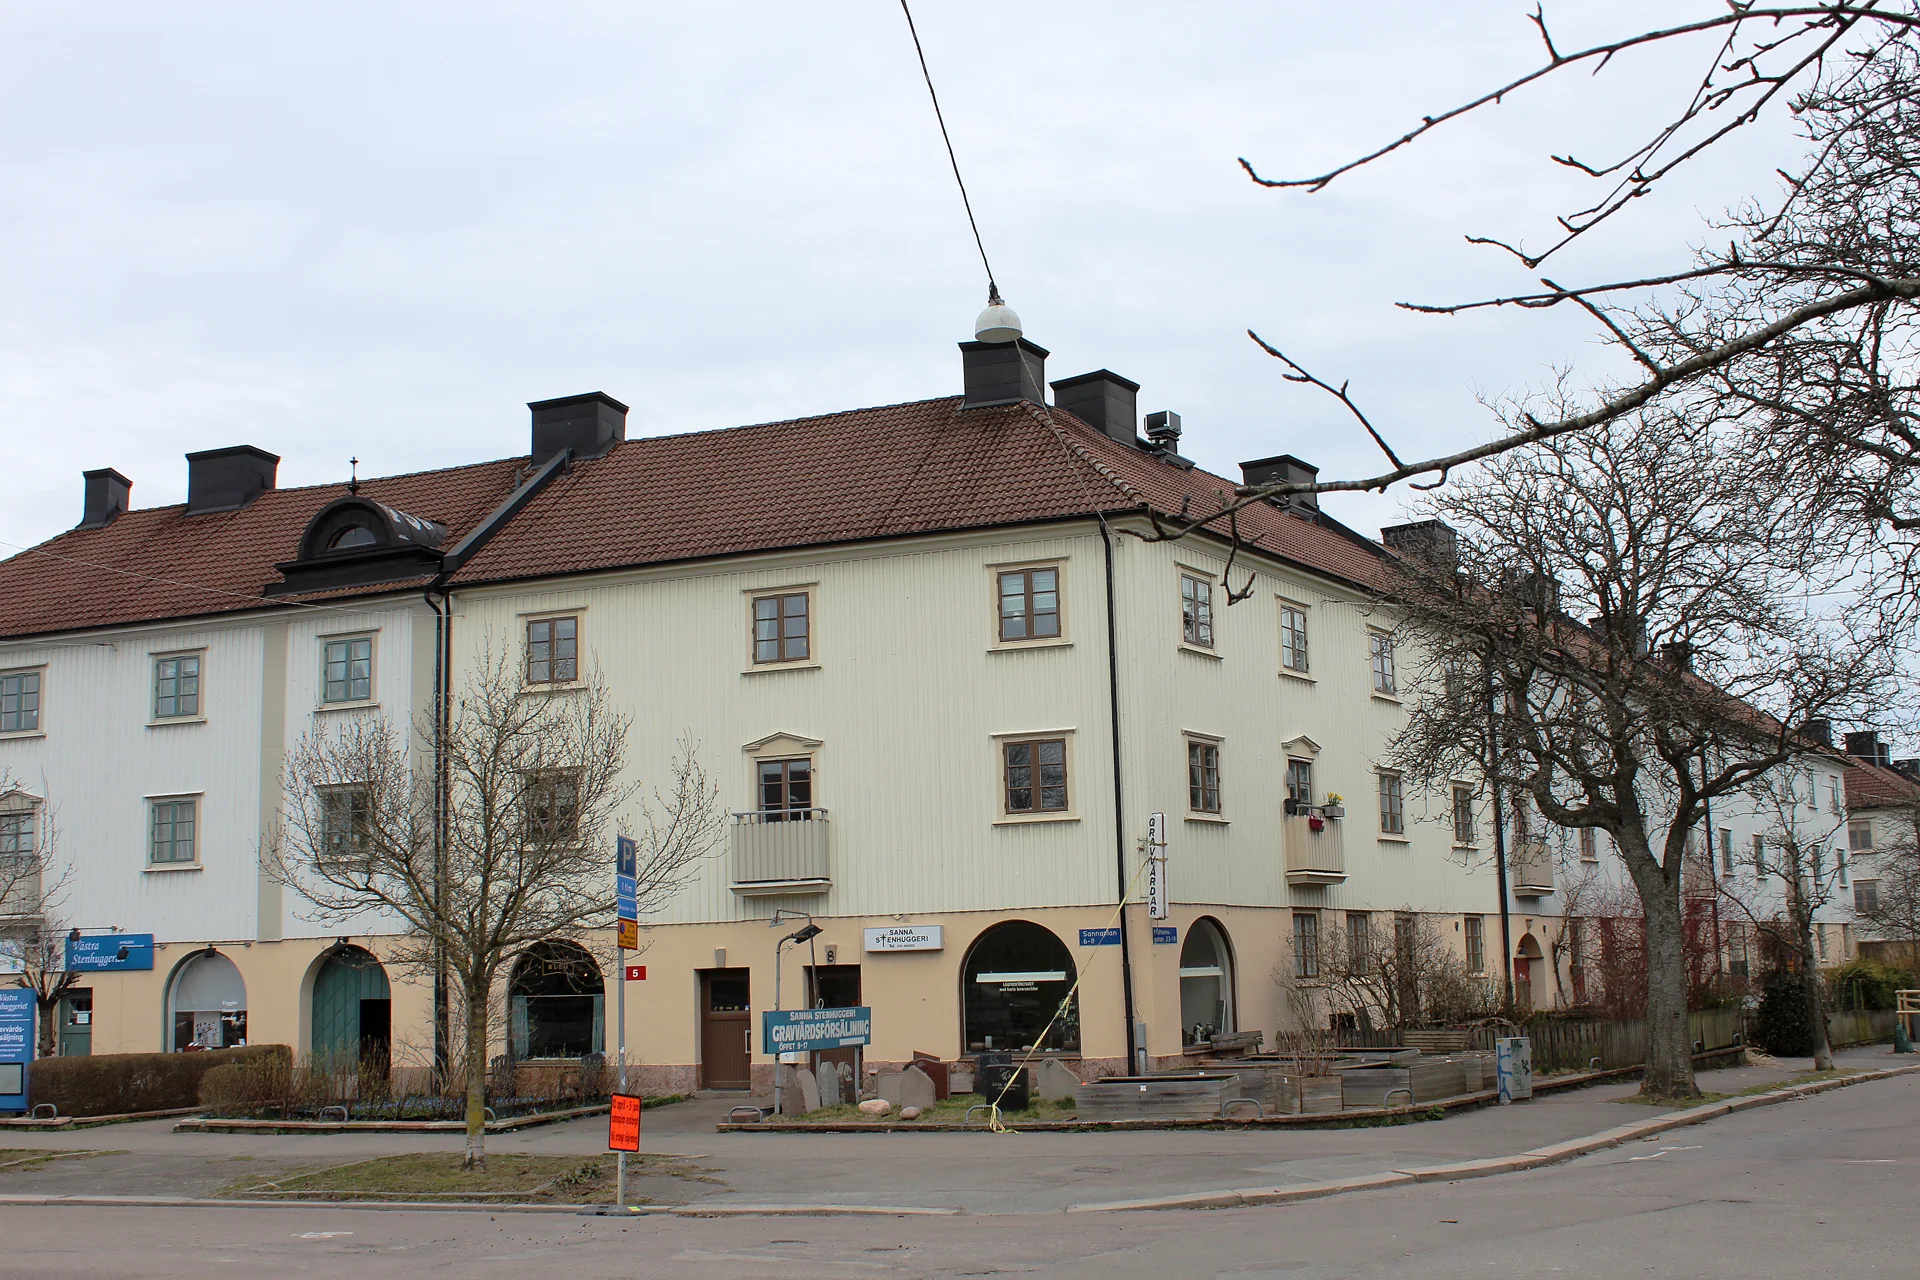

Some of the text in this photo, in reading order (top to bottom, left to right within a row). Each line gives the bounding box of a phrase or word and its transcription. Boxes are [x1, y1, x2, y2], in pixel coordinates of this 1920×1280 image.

[623, 841, 632, 870] P
[1149, 818, 1157, 916] GRAVVÅRDAR
[73, 941, 100, 951] Västra
[827, 950, 835, 962] 8
[632, 969, 639, 978] 5
[790, 1009, 856, 1020] SANNA STENHUGGERI
[772, 1019, 869, 1042] GRAVVÅRDSFÖRSÄLJNING
[779, 1042, 795, 1051] ÖPPET
